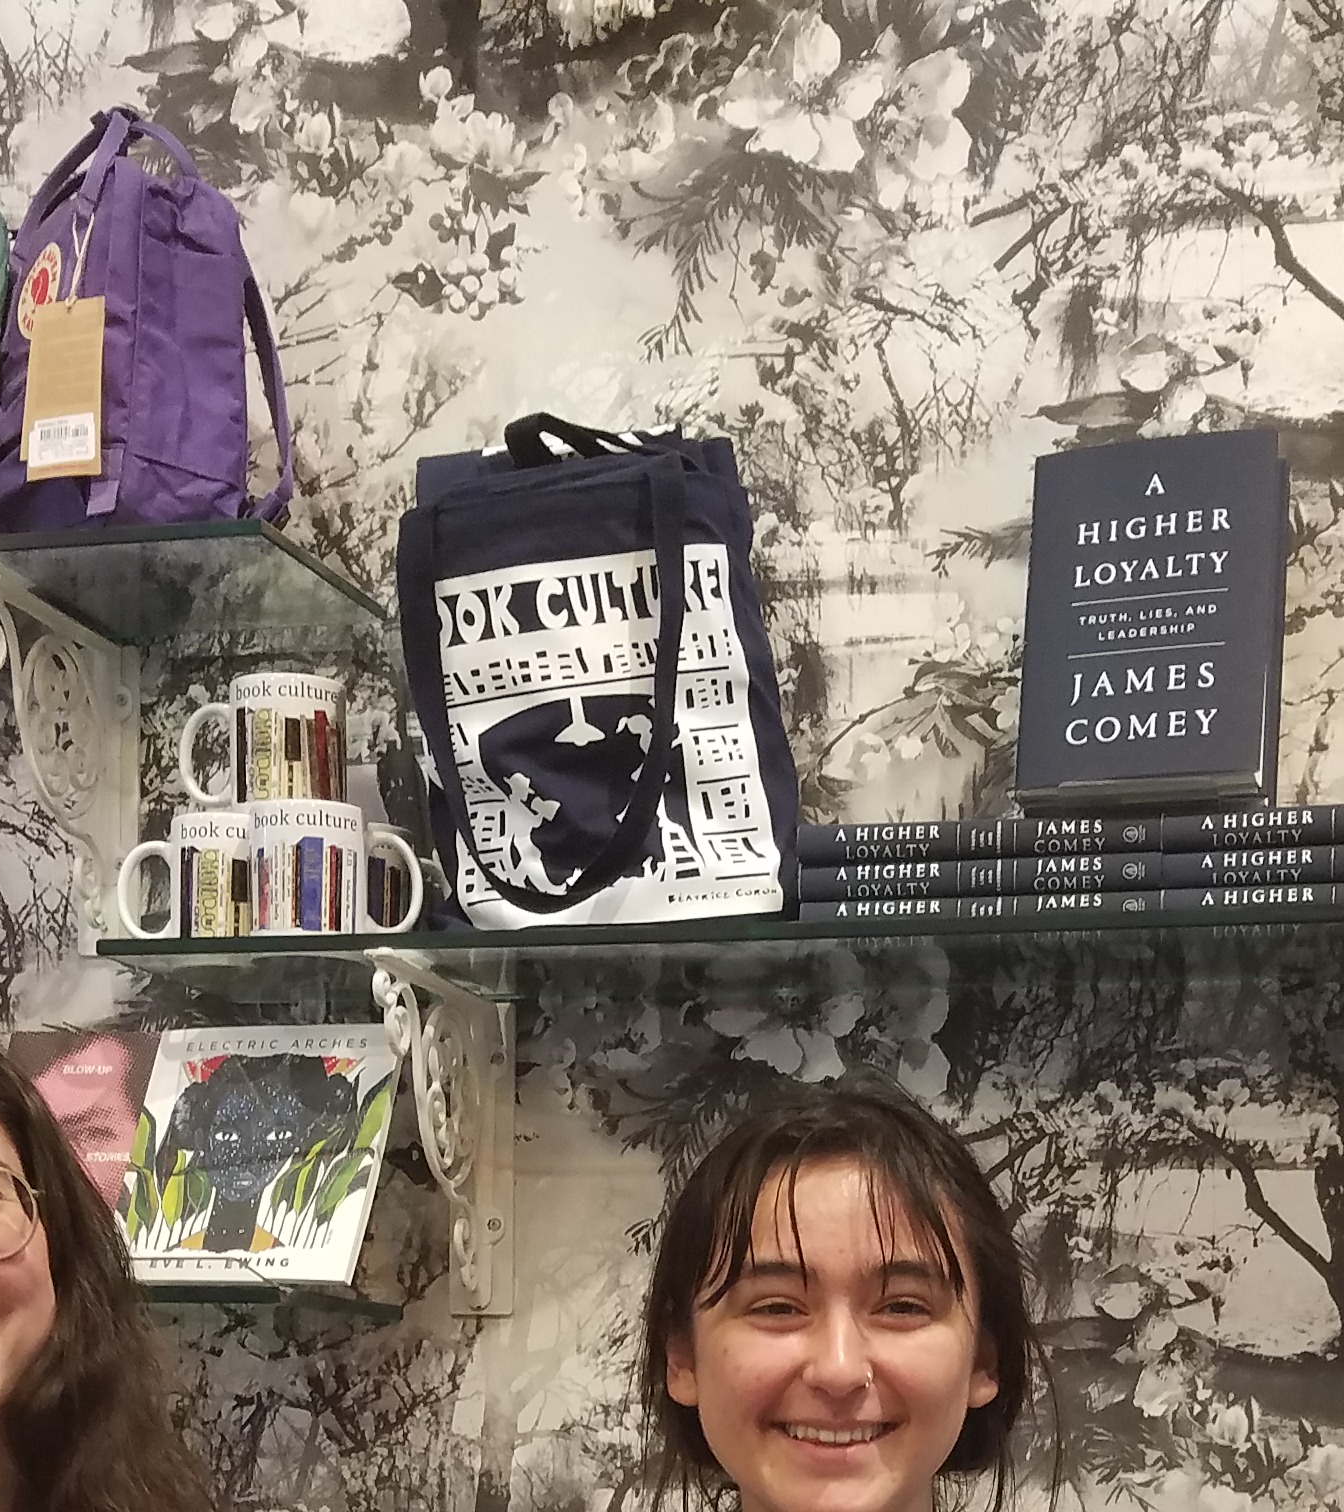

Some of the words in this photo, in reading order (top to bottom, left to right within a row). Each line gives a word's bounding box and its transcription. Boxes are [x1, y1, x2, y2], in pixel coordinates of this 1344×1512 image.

[1145, 474, 1165, 496] A
[1076, 508, 1231, 546] HIGHER
[1073, 551, 1231, 588] LOYALTY
[1079, 610, 1133, 626] TRUTH,
[1139, 606, 1178, 622] LIES,
[1185, 604, 1217, 617] AND
[1098, 623, 1196, 641] LEADERSHIP
[236, 680, 271, 701] book
[278, 682, 338, 704] culture
[1070, 662, 1216, 706] JAMES
[1065, 708, 1218, 746] COMEY
[254, 809, 289, 829] book
[296, 809, 358, 832] culture
[835, 828, 846, 842] A
[856, 825, 941, 841] HIGHER
[1037, 819, 1104, 837] JAMES
[1202, 815, 1214, 830] A
[1223, 810, 1314, 829] HIGHER
[181, 823, 219, 840] book
[1213, 829, 1303, 846] LOYALTY
[844, 843, 930, 860] LOYALTY
[1034, 836, 1106, 853] COMEY
[1201, 854, 1214, 868] A
[1223, 849, 1314, 867] HIGHER
[836, 867, 847, 881] A
[856, 863, 942, 880] HIGHER
[1036, 857, 1103, 876] JAMES
[1213, 868, 1302, 884] LOYALTY
[845, 881, 930, 898] LOYALTY
[1033, 875, 1106, 891] COMEY
[1201, 891, 1214, 906] A
[1224, 888, 1314, 905] HIGHER
[836, 903, 848, 917] A
[856, 900, 941, 916] HIGHER
[1036, 893, 1103, 911] JAMES
[186, 1039, 278, 1052] ELECTRIC
[290, 1038, 369, 1050] ARCHES
[62, 1064, 114, 1075] BLOW-UP
[149, 1258, 184, 1269] EVE
[195, 1258, 212, 1269] L.
[224, 1257, 290, 1269] EWING
